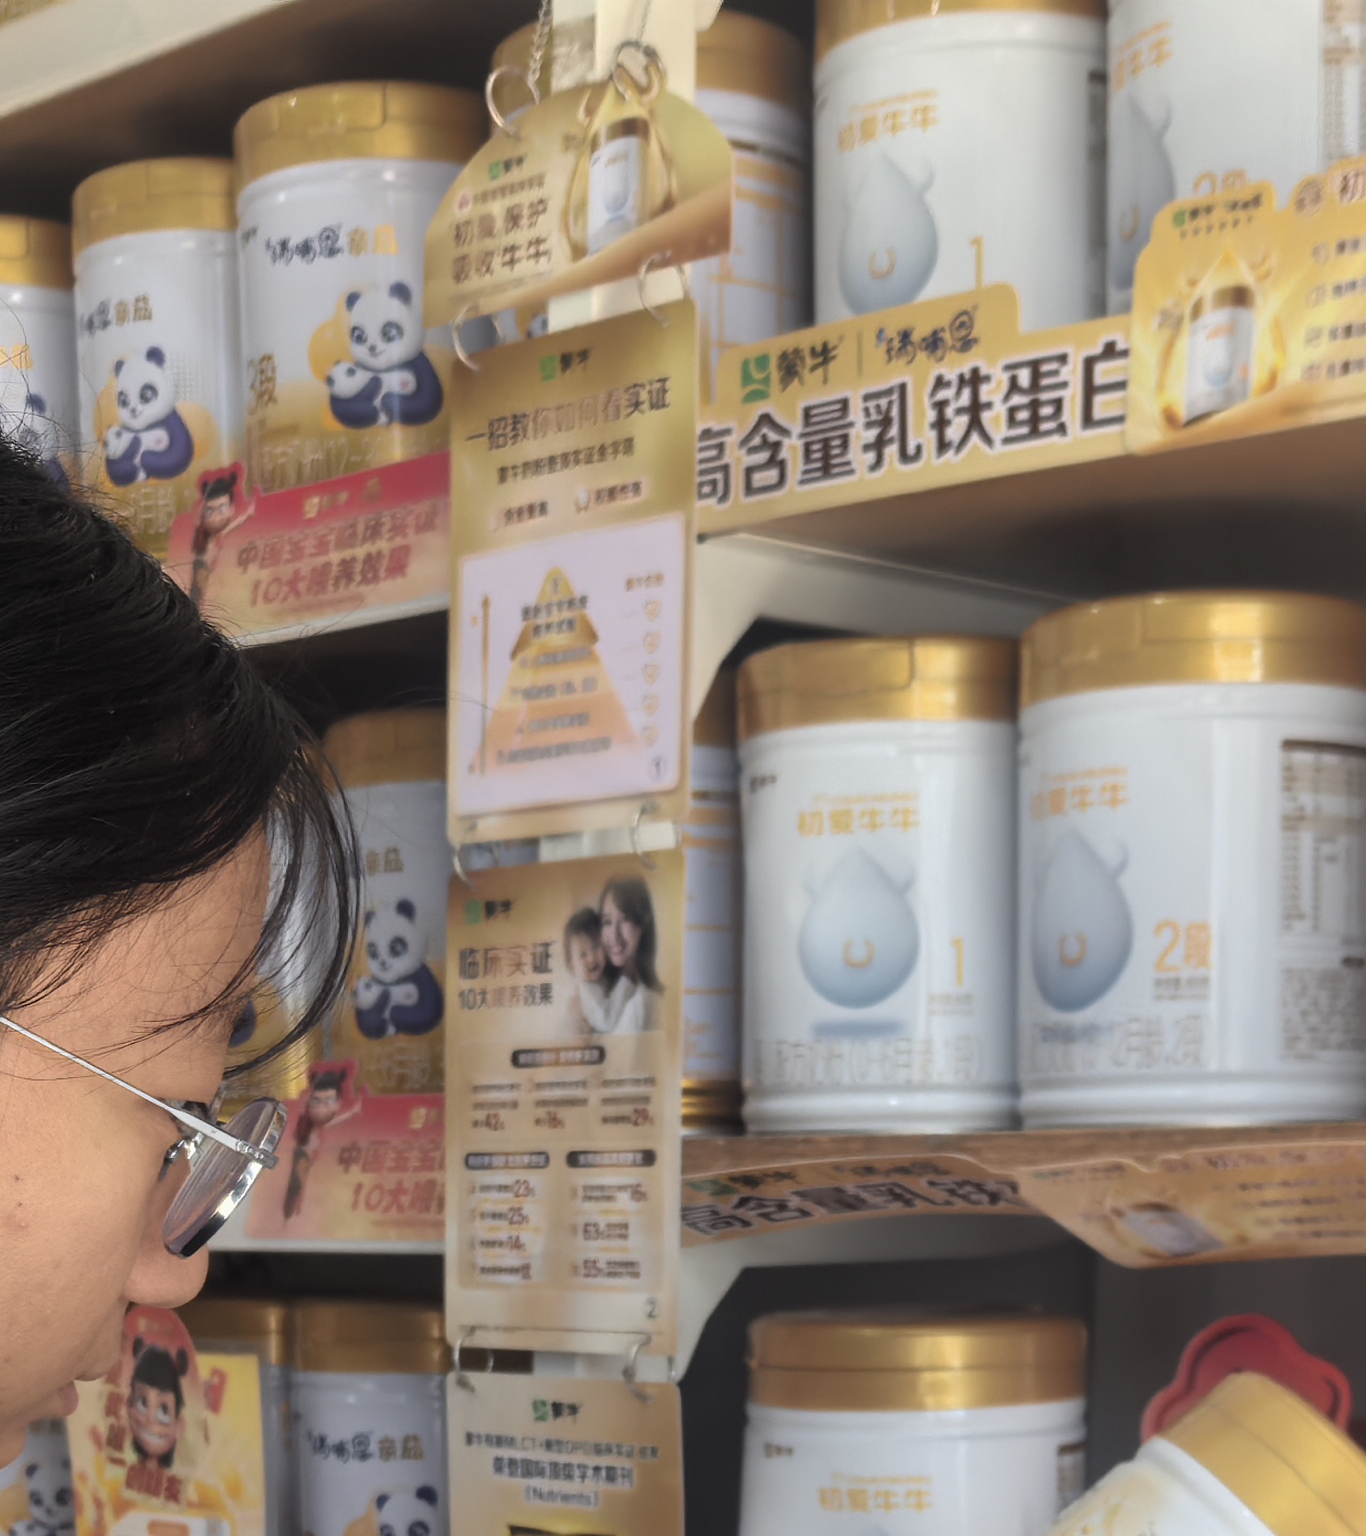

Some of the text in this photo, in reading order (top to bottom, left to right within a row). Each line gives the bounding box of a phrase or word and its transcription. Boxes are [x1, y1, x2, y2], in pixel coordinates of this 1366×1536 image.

[776, 338, 840, 390] 蒙牛
[464, 377, 672, 452] 一招教你如何看实证
[696, 343, 1132, 508] 高含量乳铁蛋白
[797, 804, 921, 838] 初爱牛牛
[458, 942, 556, 982] 临床实证
[338, 1137, 446, 1176] 中国宝宝
